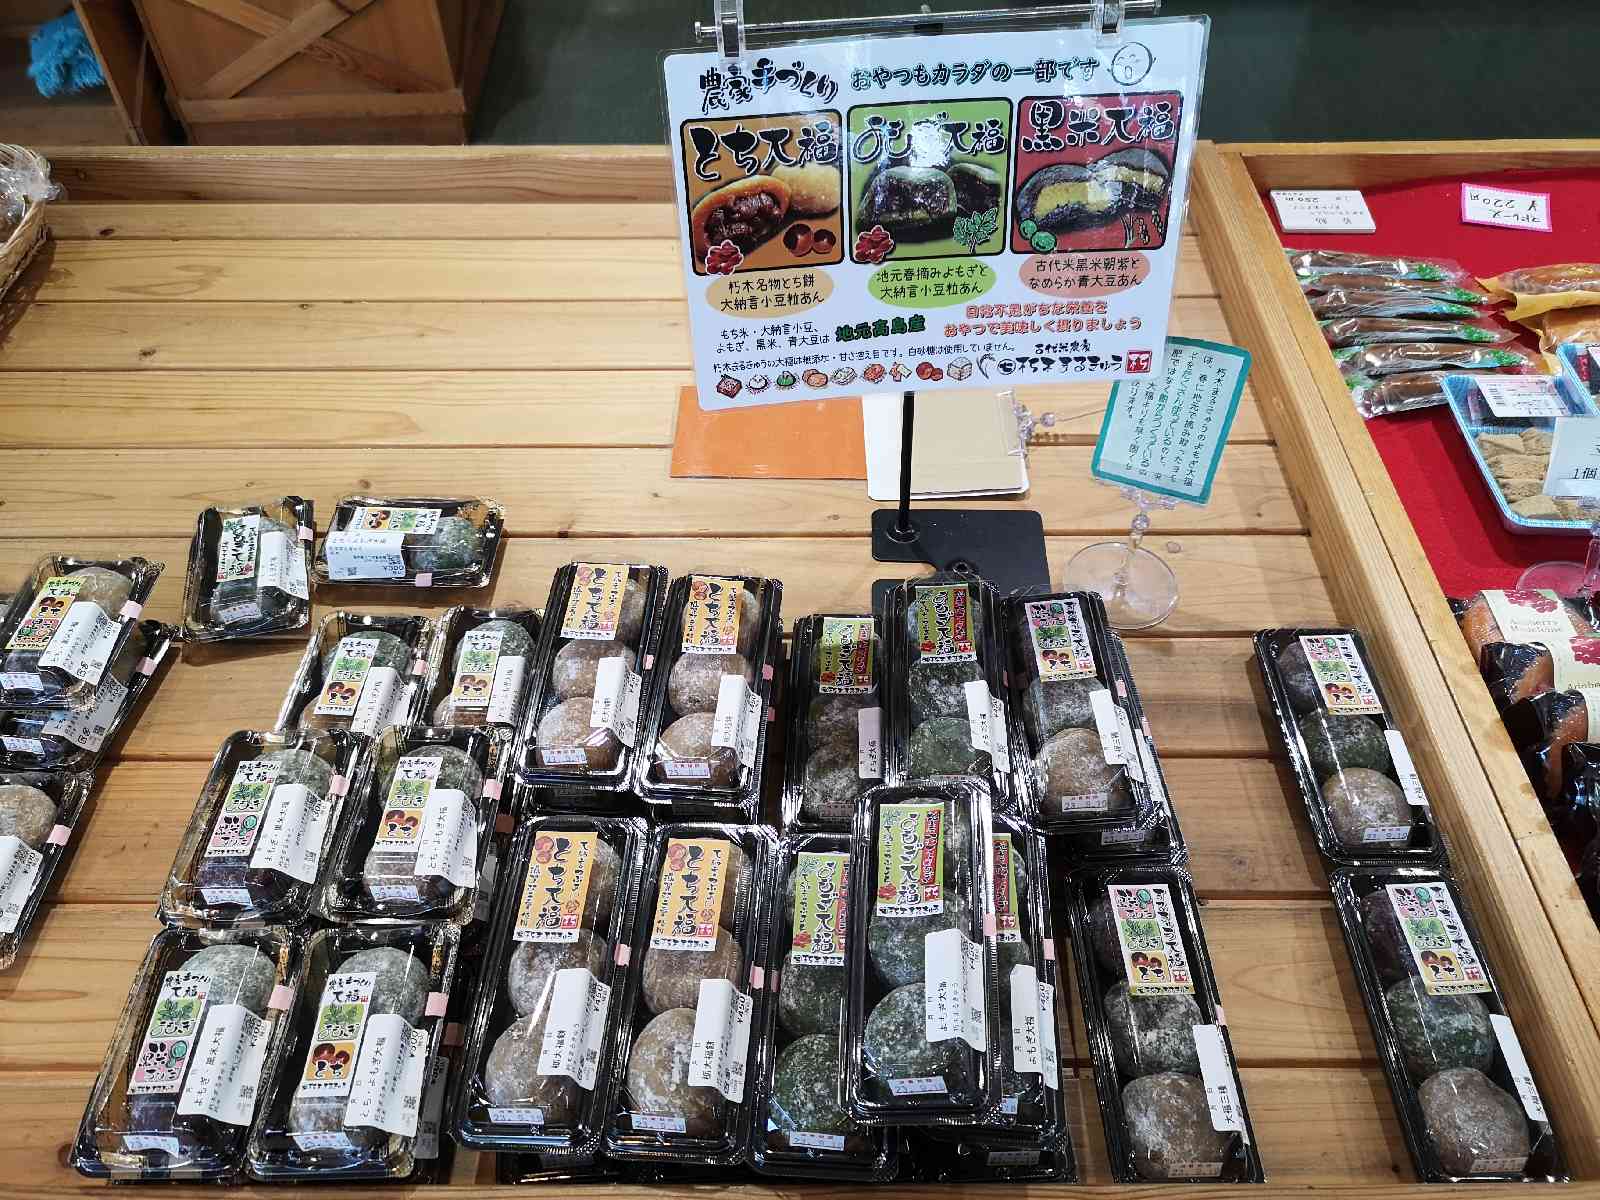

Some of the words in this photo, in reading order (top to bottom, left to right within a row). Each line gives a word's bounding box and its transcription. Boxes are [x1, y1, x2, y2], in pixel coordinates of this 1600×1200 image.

[851, 57, 1099, 91] おやつもカラダの一部です
[853, 112, 1006, 164] よも大福
[1021, 100, 1175, 152] 黒米大福
[688, 119, 839, 181] とち大福
[728, 273, 815, 294] 朽木名物とち餅
[877, 264, 988, 283] 地元春摘みよもぎと
[880, 281, 983, 300] 大納言小豆粒あん
[1029, 273, 1142, 289] なめらか青大豆あん
[720, 290, 825, 312] 大納言小豆粒あん
[835, 314, 926, 343] 地元高島産
[897, 812, 925, 905] よもぎ大福
[535, 836, 572, 929] とち大福
[672, 844, 705, 937] とち大福
